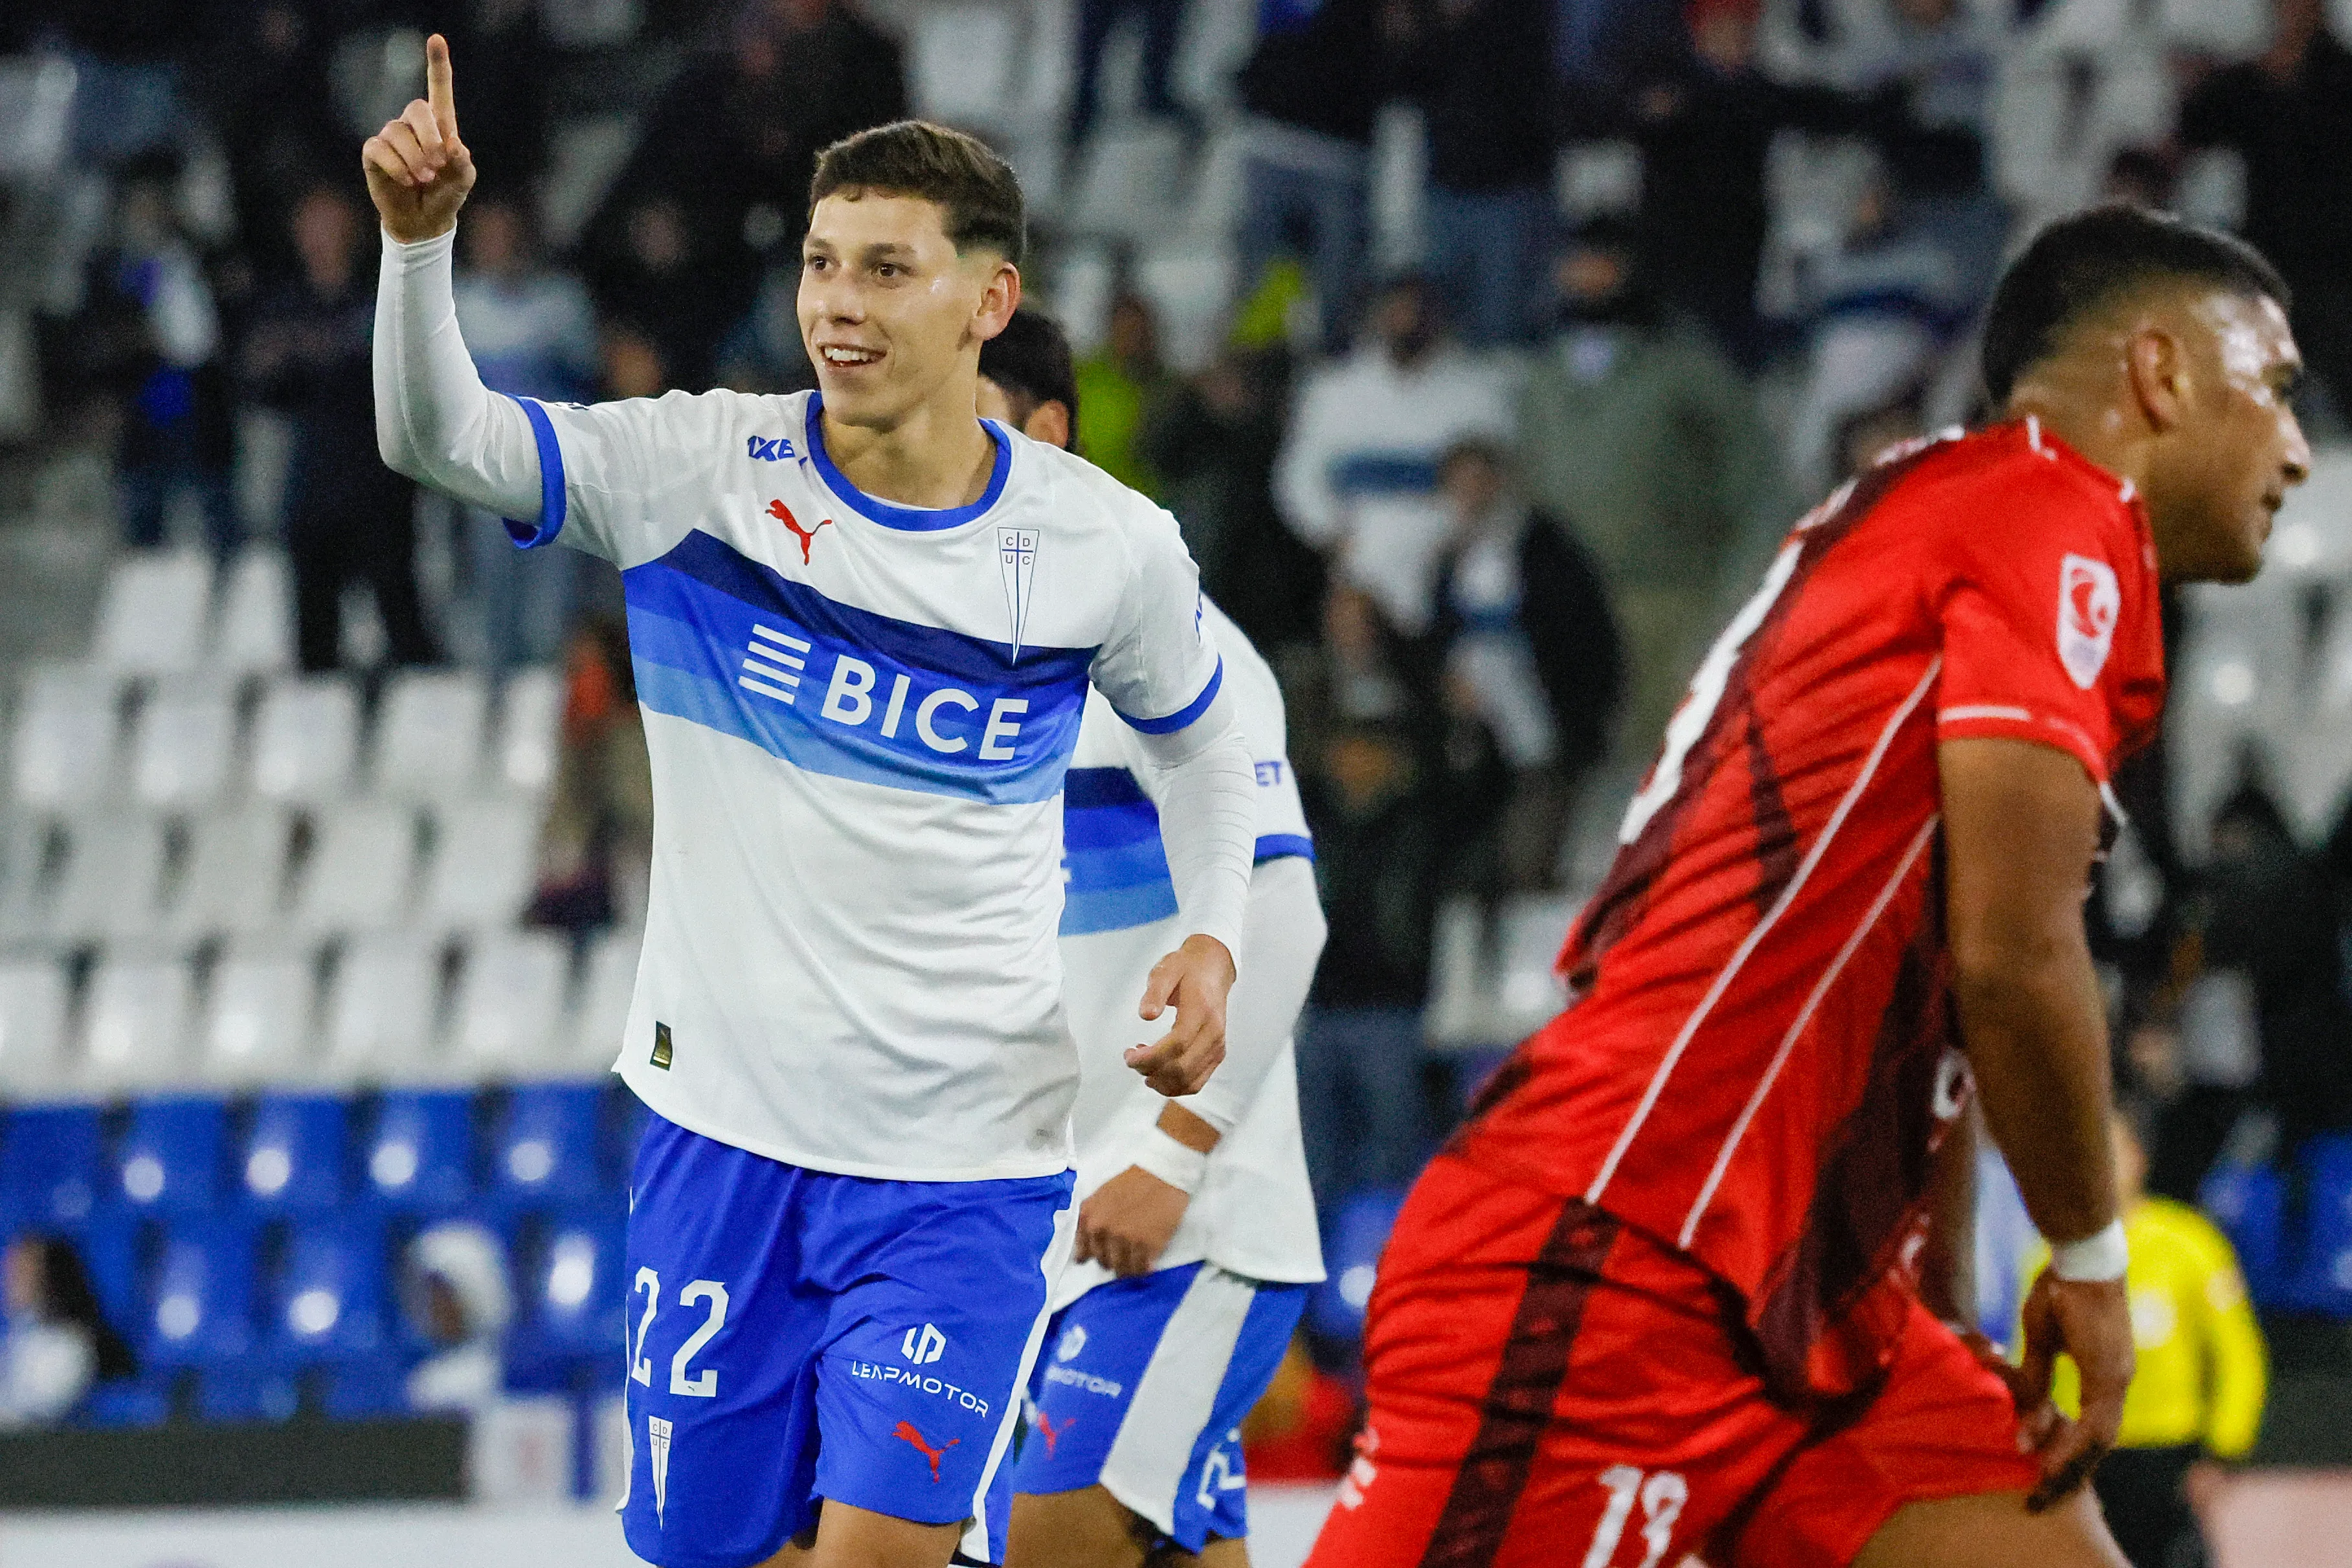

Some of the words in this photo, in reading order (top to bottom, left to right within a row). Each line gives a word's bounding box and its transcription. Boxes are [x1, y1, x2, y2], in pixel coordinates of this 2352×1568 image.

[821, 654, 1029, 761] BICE
[1254, 761, 1282, 787] ET
[631, 1266, 729, 1397] 22
[852, 1360, 989, 1418] LEAPMOTOR
